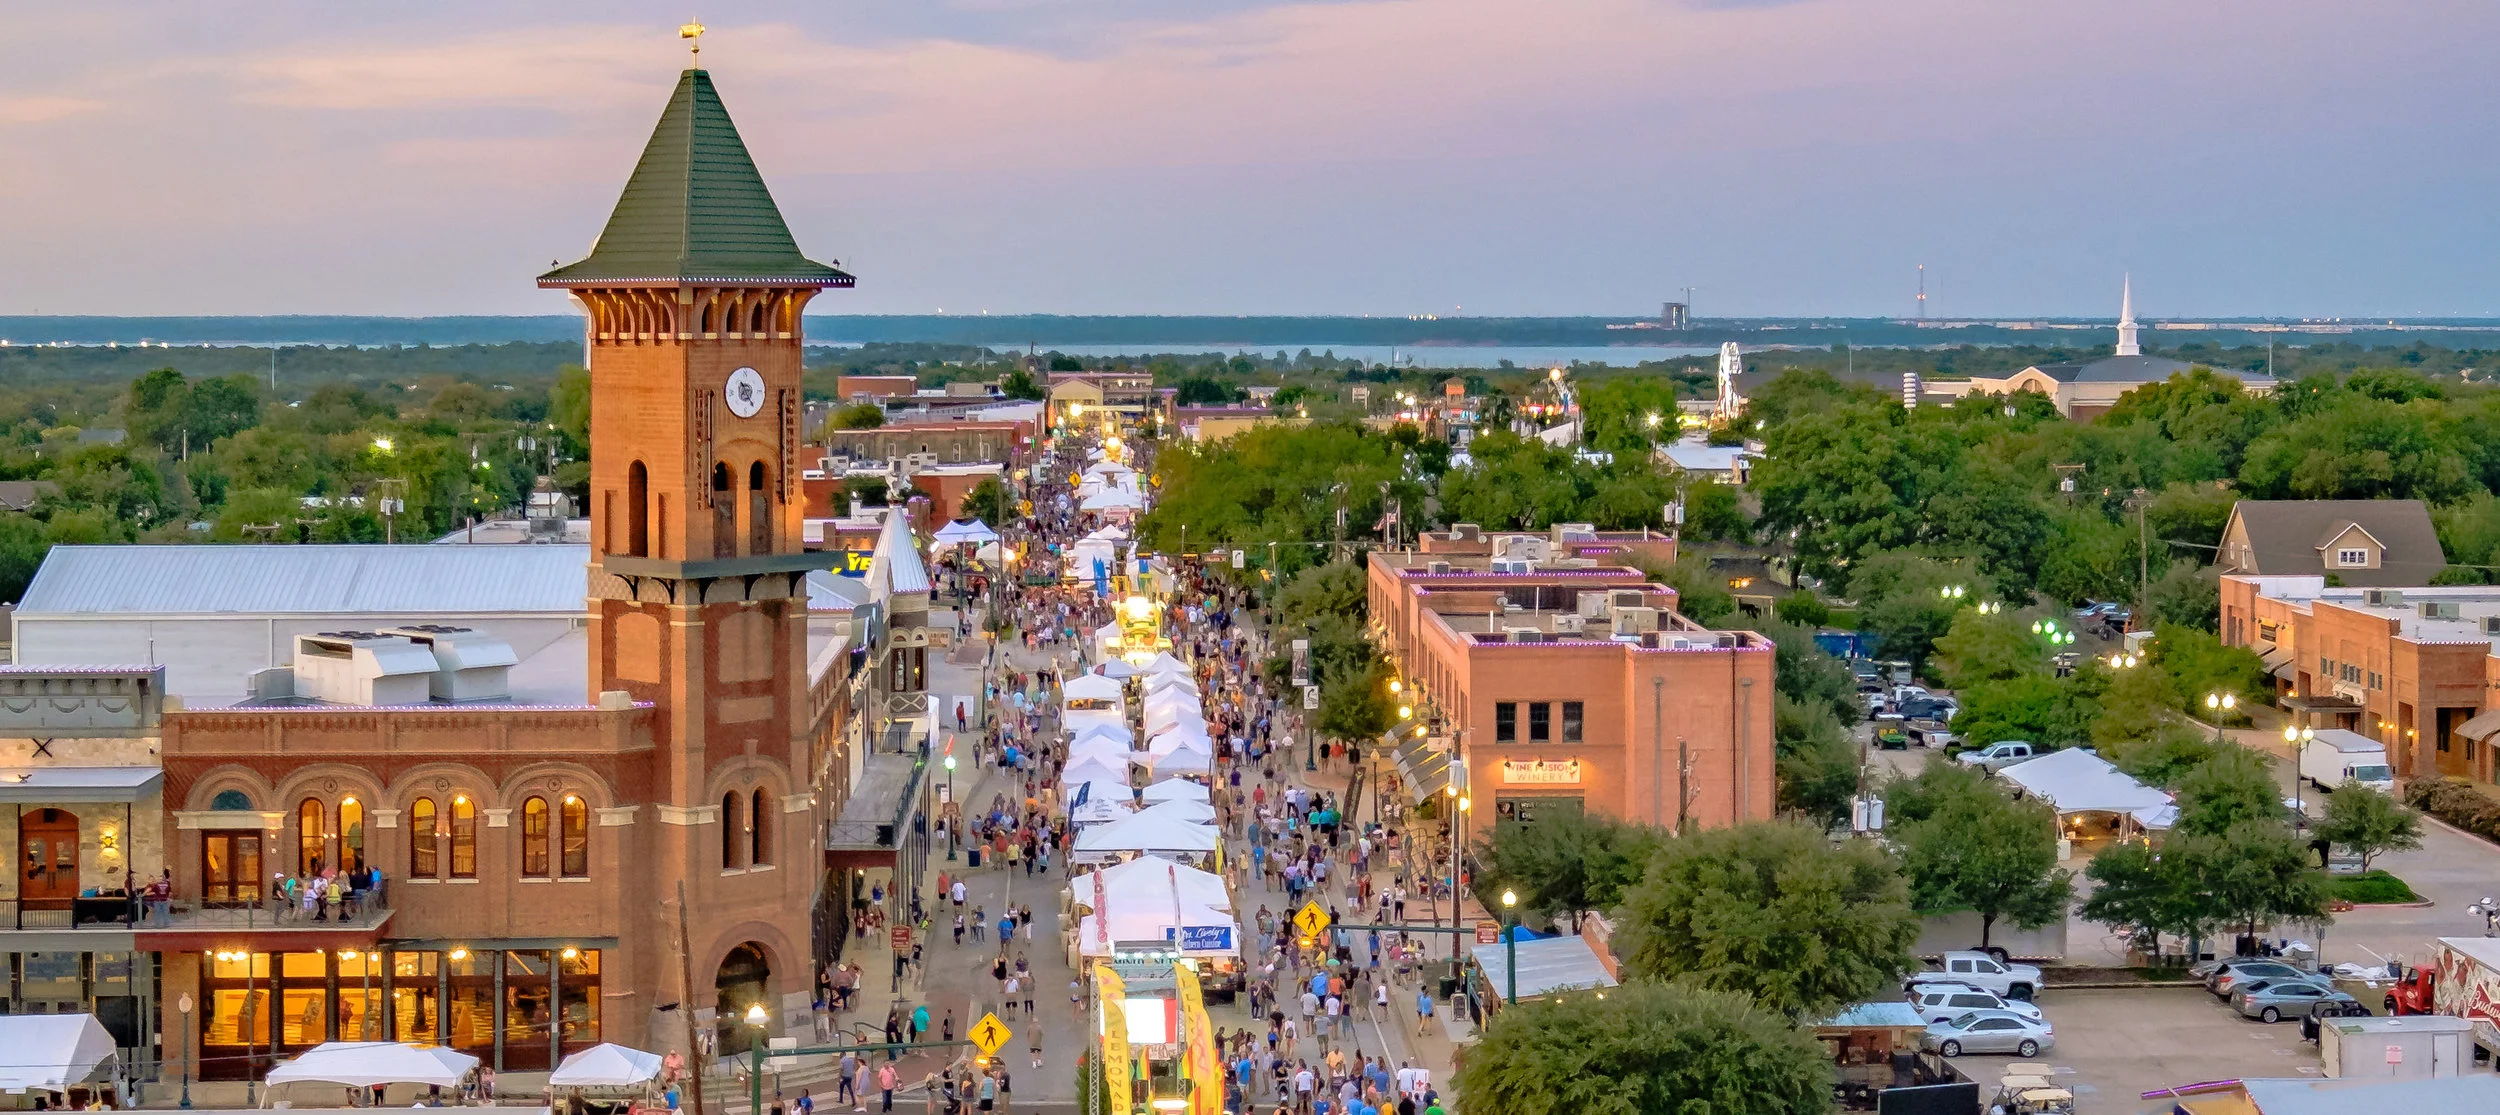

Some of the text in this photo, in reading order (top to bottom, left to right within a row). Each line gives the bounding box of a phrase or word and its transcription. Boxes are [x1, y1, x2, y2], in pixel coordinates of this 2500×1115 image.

[1507, 763, 1532, 772] WINE
[1517, 773, 1563, 781] WINERY
[2468, 990, 2500, 1018] Budw
